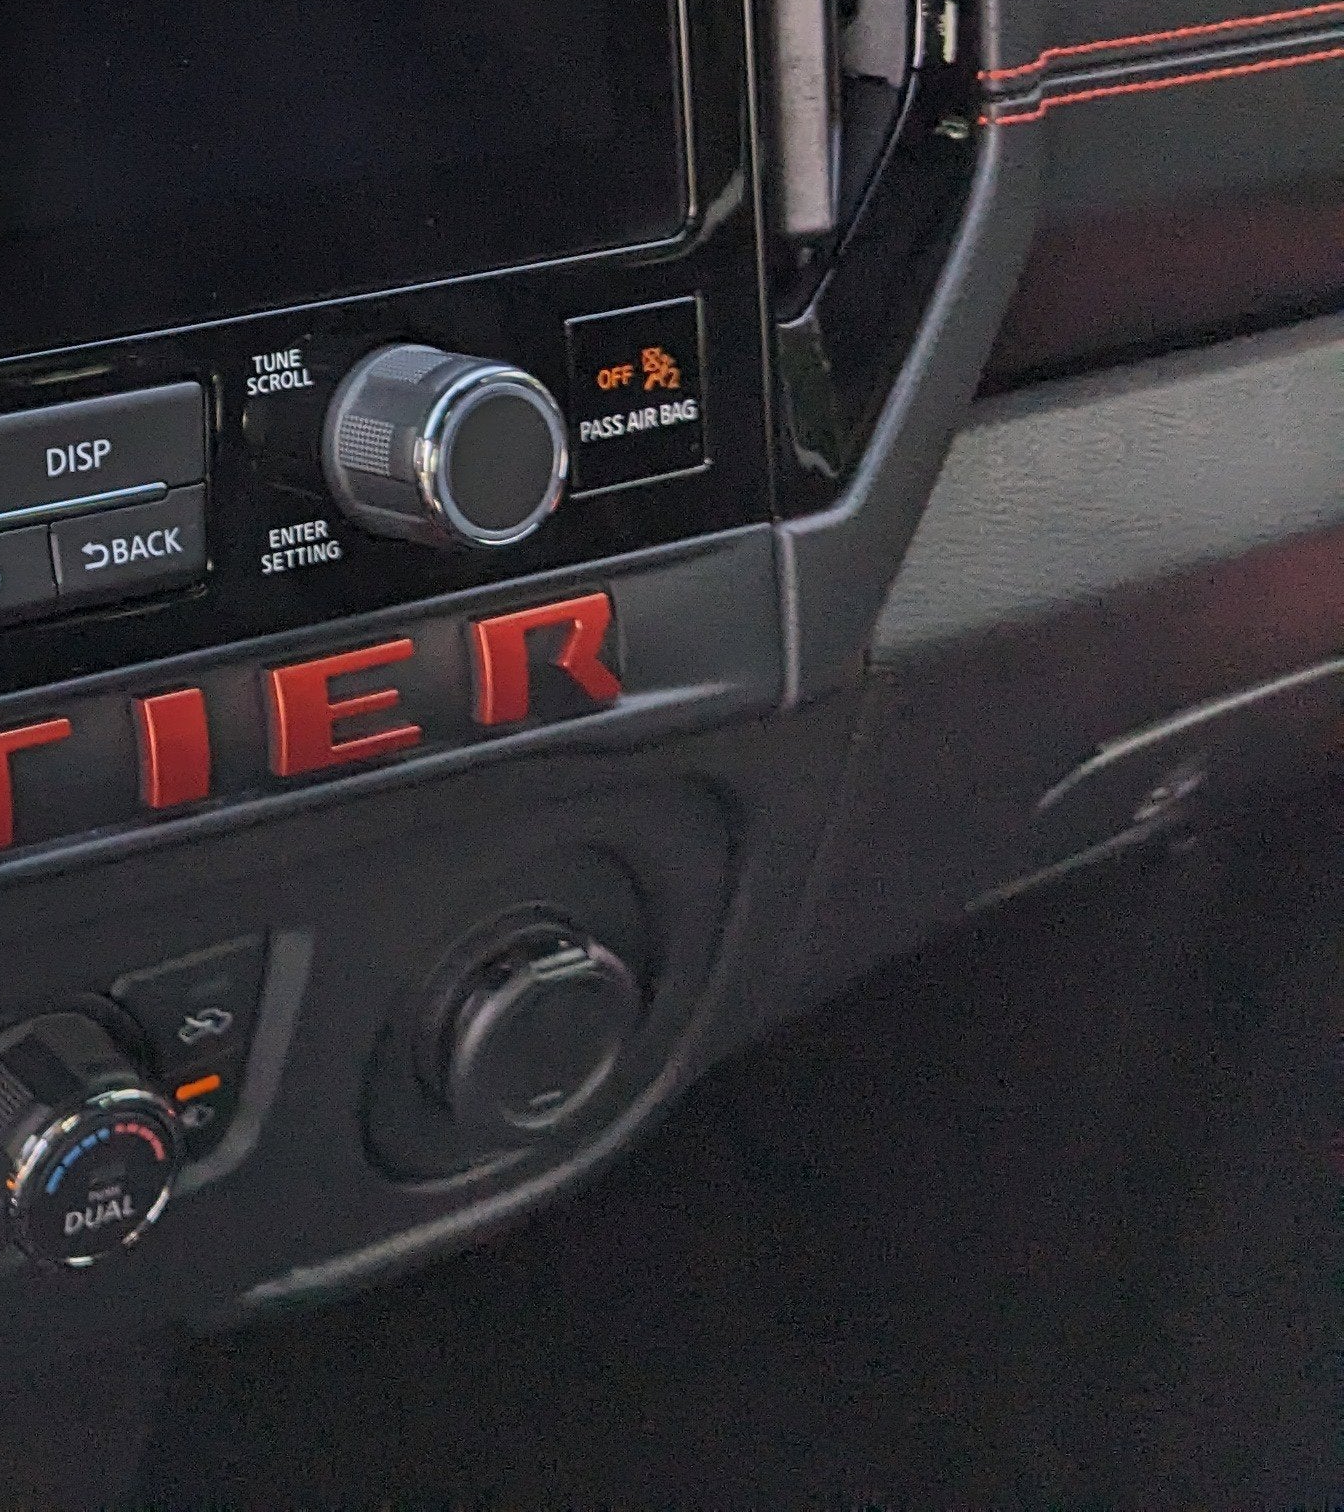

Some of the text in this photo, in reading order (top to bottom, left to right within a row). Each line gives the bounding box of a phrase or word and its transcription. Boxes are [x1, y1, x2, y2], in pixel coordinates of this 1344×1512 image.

[252, 348, 303, 376] TUNE
[597, 364, 634, 390] OFF
[246, 369, 313, 395] SCROLL
[579, 398, 700, 443] PASS AIR BAG
[45, 438, 111, 477] DISP
[110, 528, 183, 565] BACK
[268, 519, 328, 549] ENTER
[261, 539, 343, 575] SETTING
[64, 1194, 134, 1235] DUAL
